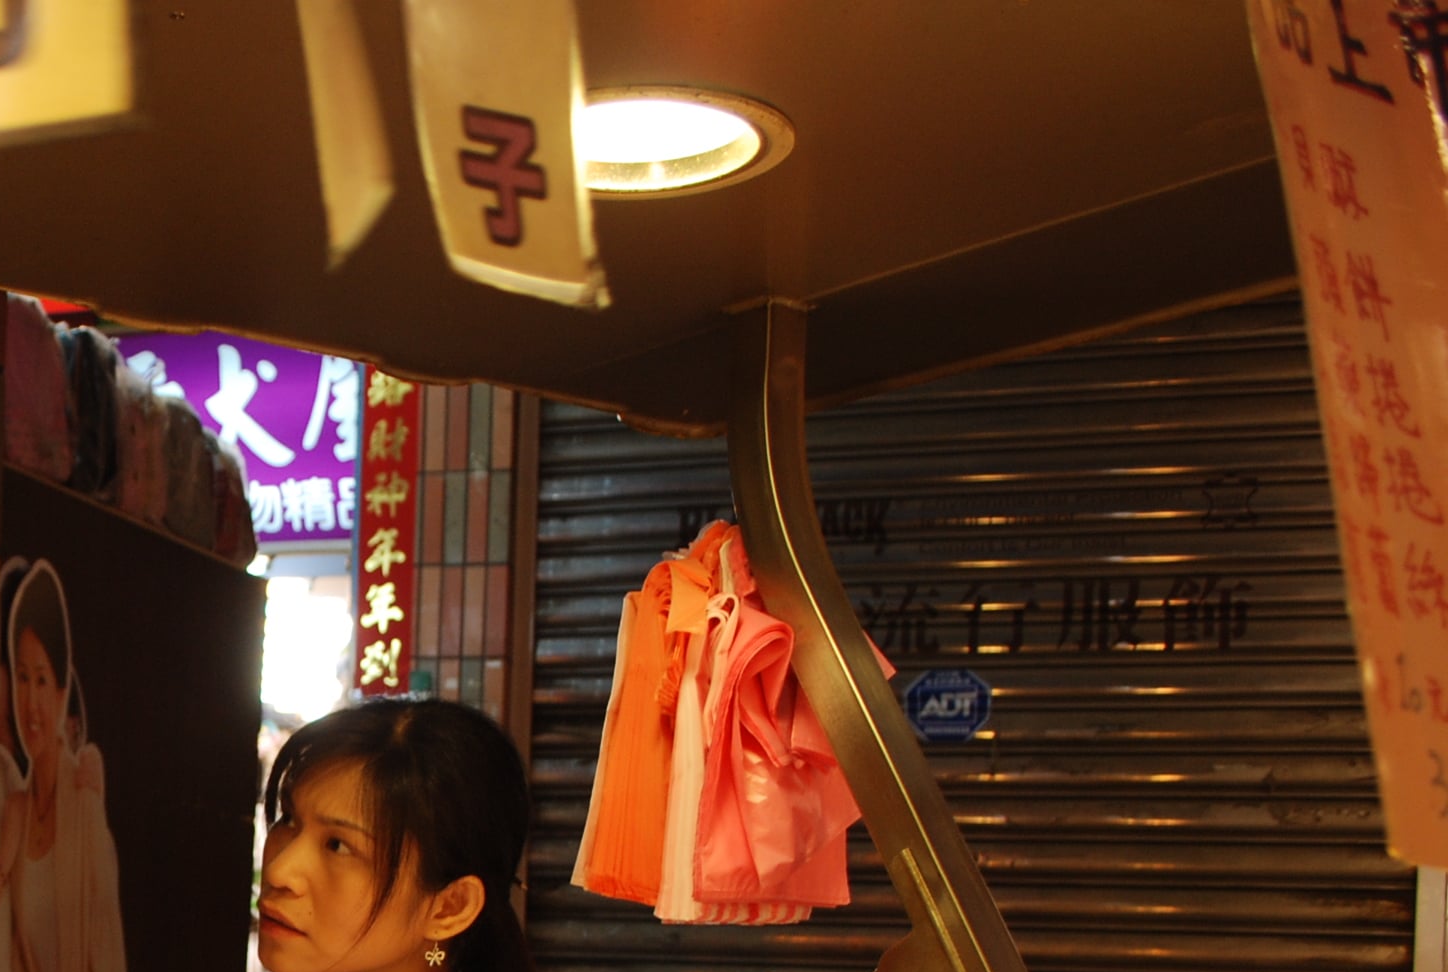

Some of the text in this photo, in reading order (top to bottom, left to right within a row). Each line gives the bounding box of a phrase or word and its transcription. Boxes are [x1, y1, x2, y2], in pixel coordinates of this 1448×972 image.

[460, 105, 546, 248] 子
[862, 575, 1253, 655] 流行服飾
[919, 691, 978, 719] ADT
